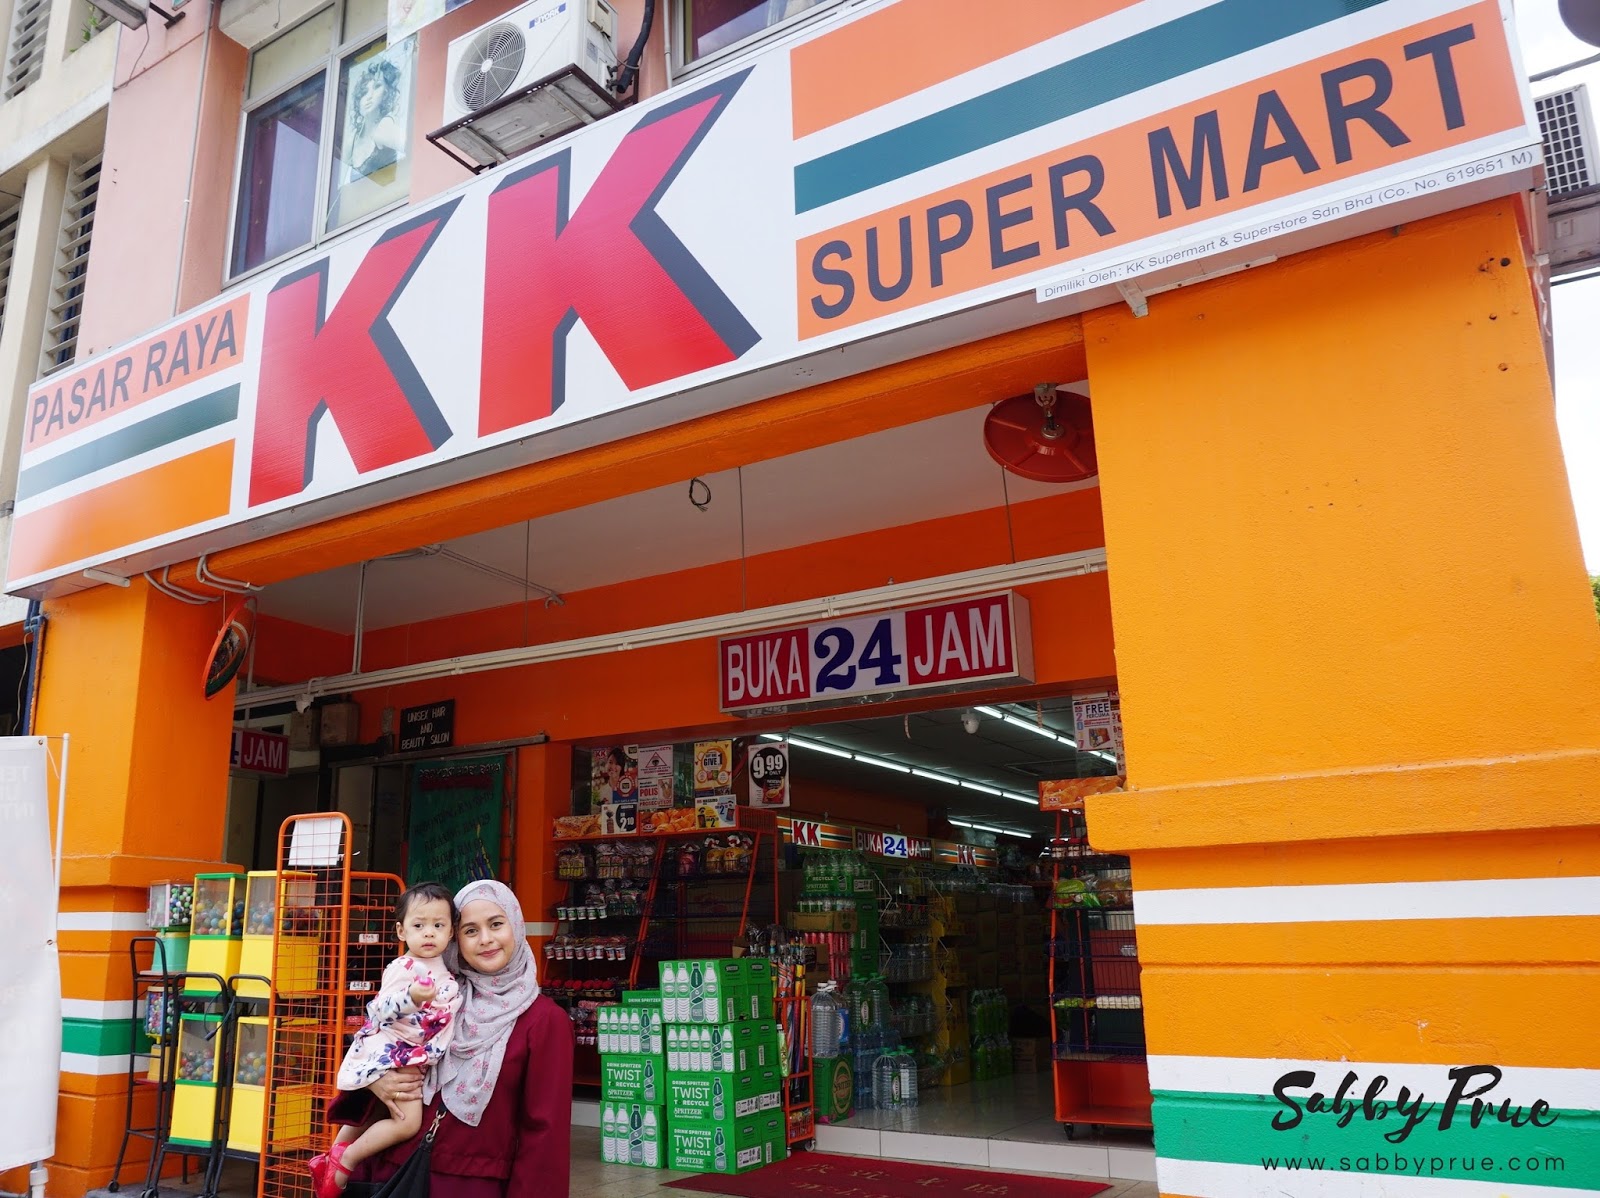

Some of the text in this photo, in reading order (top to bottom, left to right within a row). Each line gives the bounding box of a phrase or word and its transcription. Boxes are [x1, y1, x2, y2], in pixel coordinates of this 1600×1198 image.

[810, 23, 1476, 320] SUPER MART
[1045, 277, 1086, 298] Dimiliki
[1126, 259, 1145, 275] KK
[1148, 240, 1216, 268] Supermart
[1219, 236, 1230, 248] &
[1233, 215, 1308, 243] Superstore
[1312, 204, 1340, 220] Sdn
[1344, 194, 1373, 211] Bhd
[1379, 186, 1410, 203] (Co.
[1415, 179, 1441, 192] No.
[1446, 158, 1504, 183] 619651
[1511, 150, 1533, 166] M)
[248, 64, 763, 508] KK
[30, 309, 237, 443] PASAR RAYA
[727, 604, 1006, 701] BUKA 24 JAM
[407, 706, 446, 722] UNISEX HAIR
[1085, 703, 1110, 714] FREE
[420, 722, 433, 734] AND
[401, 731, 450, 750] BEAUTY SALON
[243, 737, 283, 769] JAM
[703, 758, 717, 766] GIVE
[640, 787, 659, 797] POLIS
[793, 820, 820, 846] KK
[857, 831, 883, 852] BUKA
[883, 836, 907, 857] 24
[606, 1068, 642, 1081] TWIST
[672, 1086, 710, 1100] TWIST
[674, 1134, 712, 1149] TWIST
